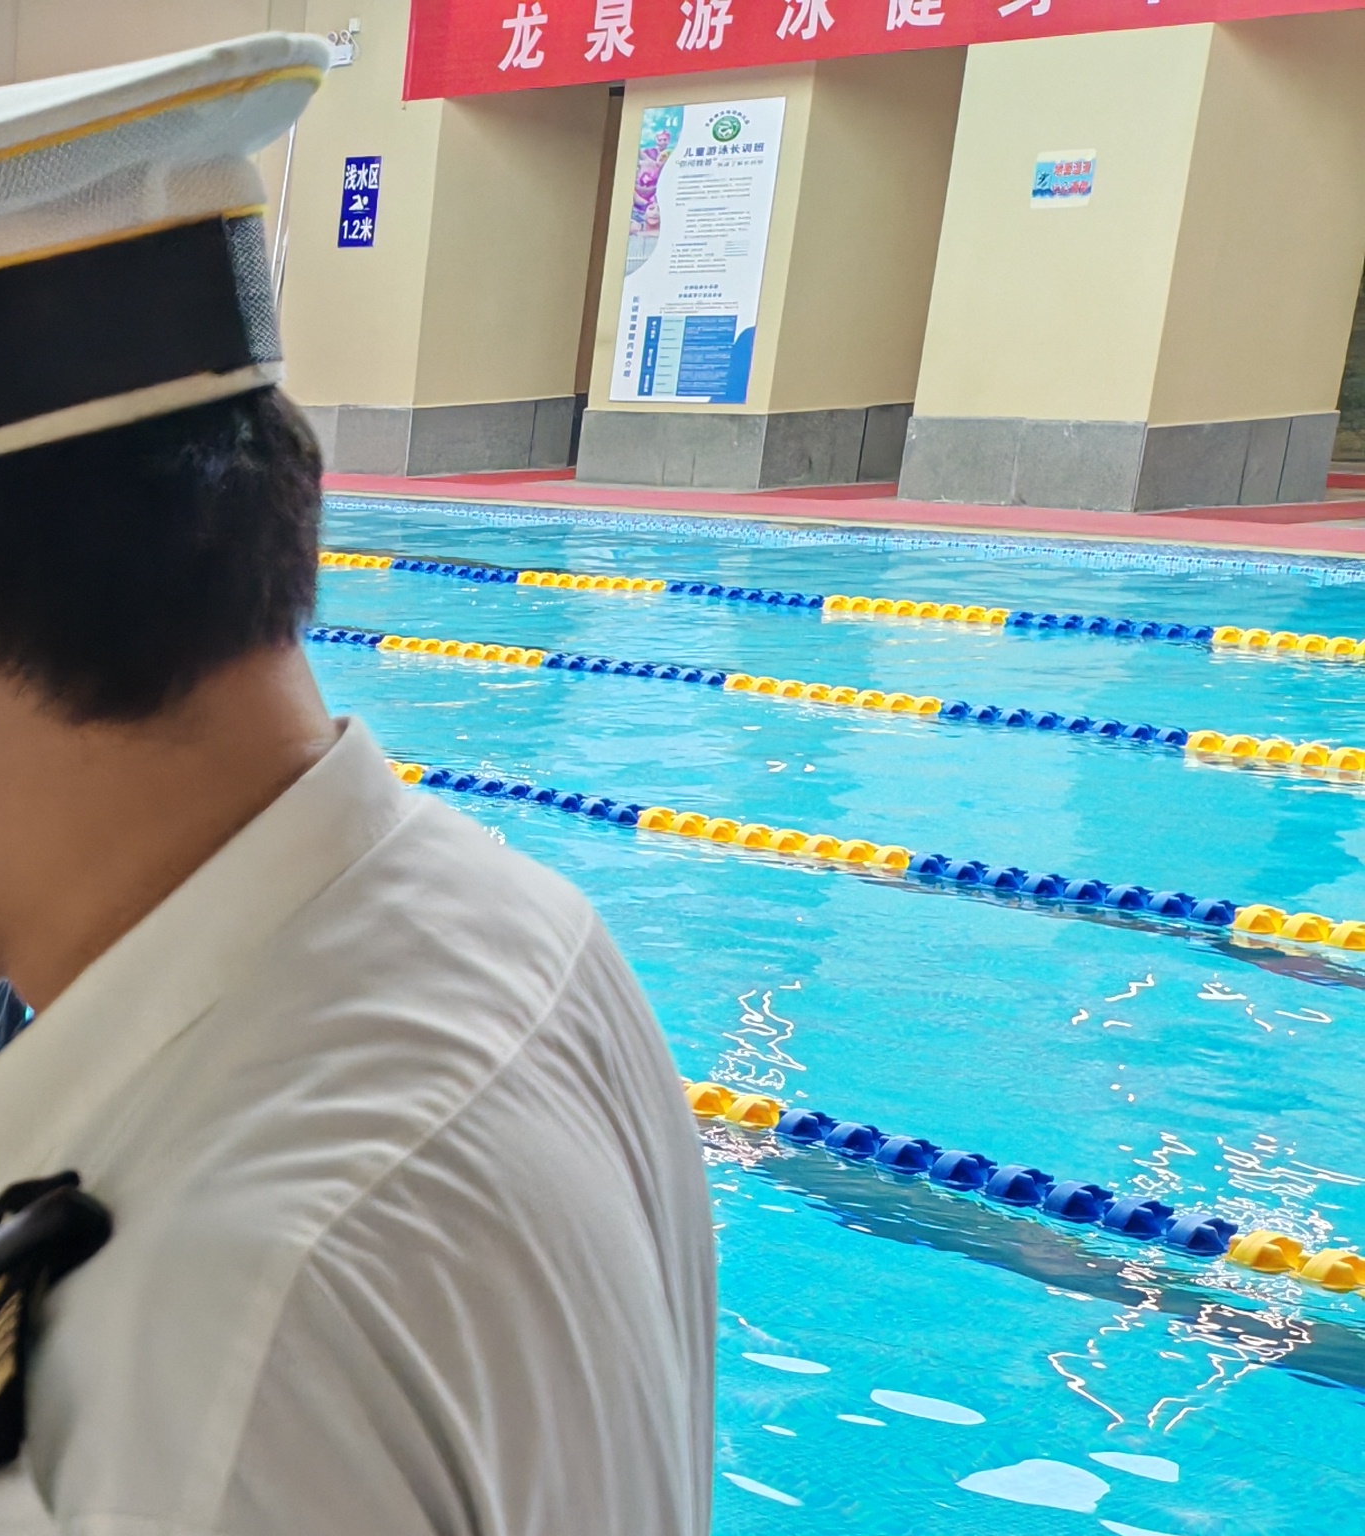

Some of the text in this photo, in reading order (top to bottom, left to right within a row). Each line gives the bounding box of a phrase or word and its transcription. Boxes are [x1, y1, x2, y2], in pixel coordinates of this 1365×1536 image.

[499, 0, 1159, 72] 龙泉游泳健
[344, 162, 380, 190] 浅水区
[342, 216, 373, 241] 1.2米
